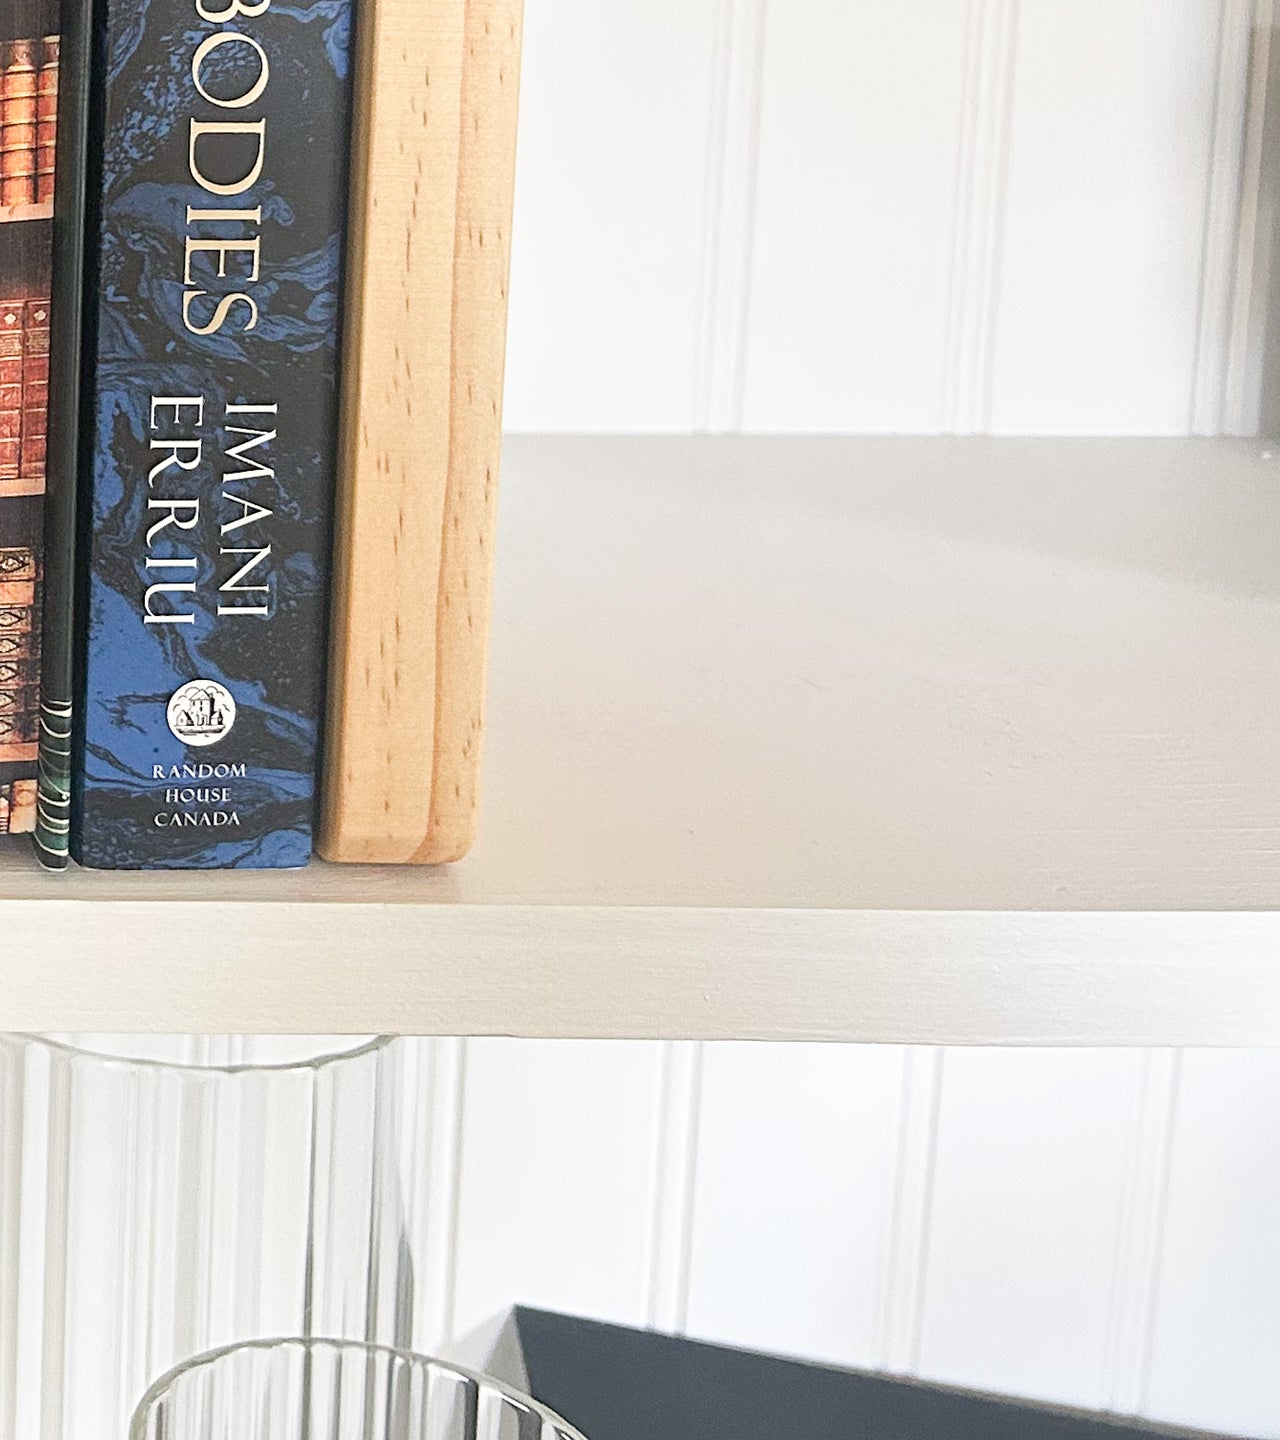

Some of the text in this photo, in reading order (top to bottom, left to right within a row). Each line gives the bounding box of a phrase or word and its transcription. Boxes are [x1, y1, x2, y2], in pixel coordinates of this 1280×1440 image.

[142, 394, 204, 626] ERRIU
[217, 400, 278, 618] IMANI
[152, 763, 247, 779] RANDOM
[165, 787, 232, 803] HOUSE
[154, 811, 241, 827] CANADA
